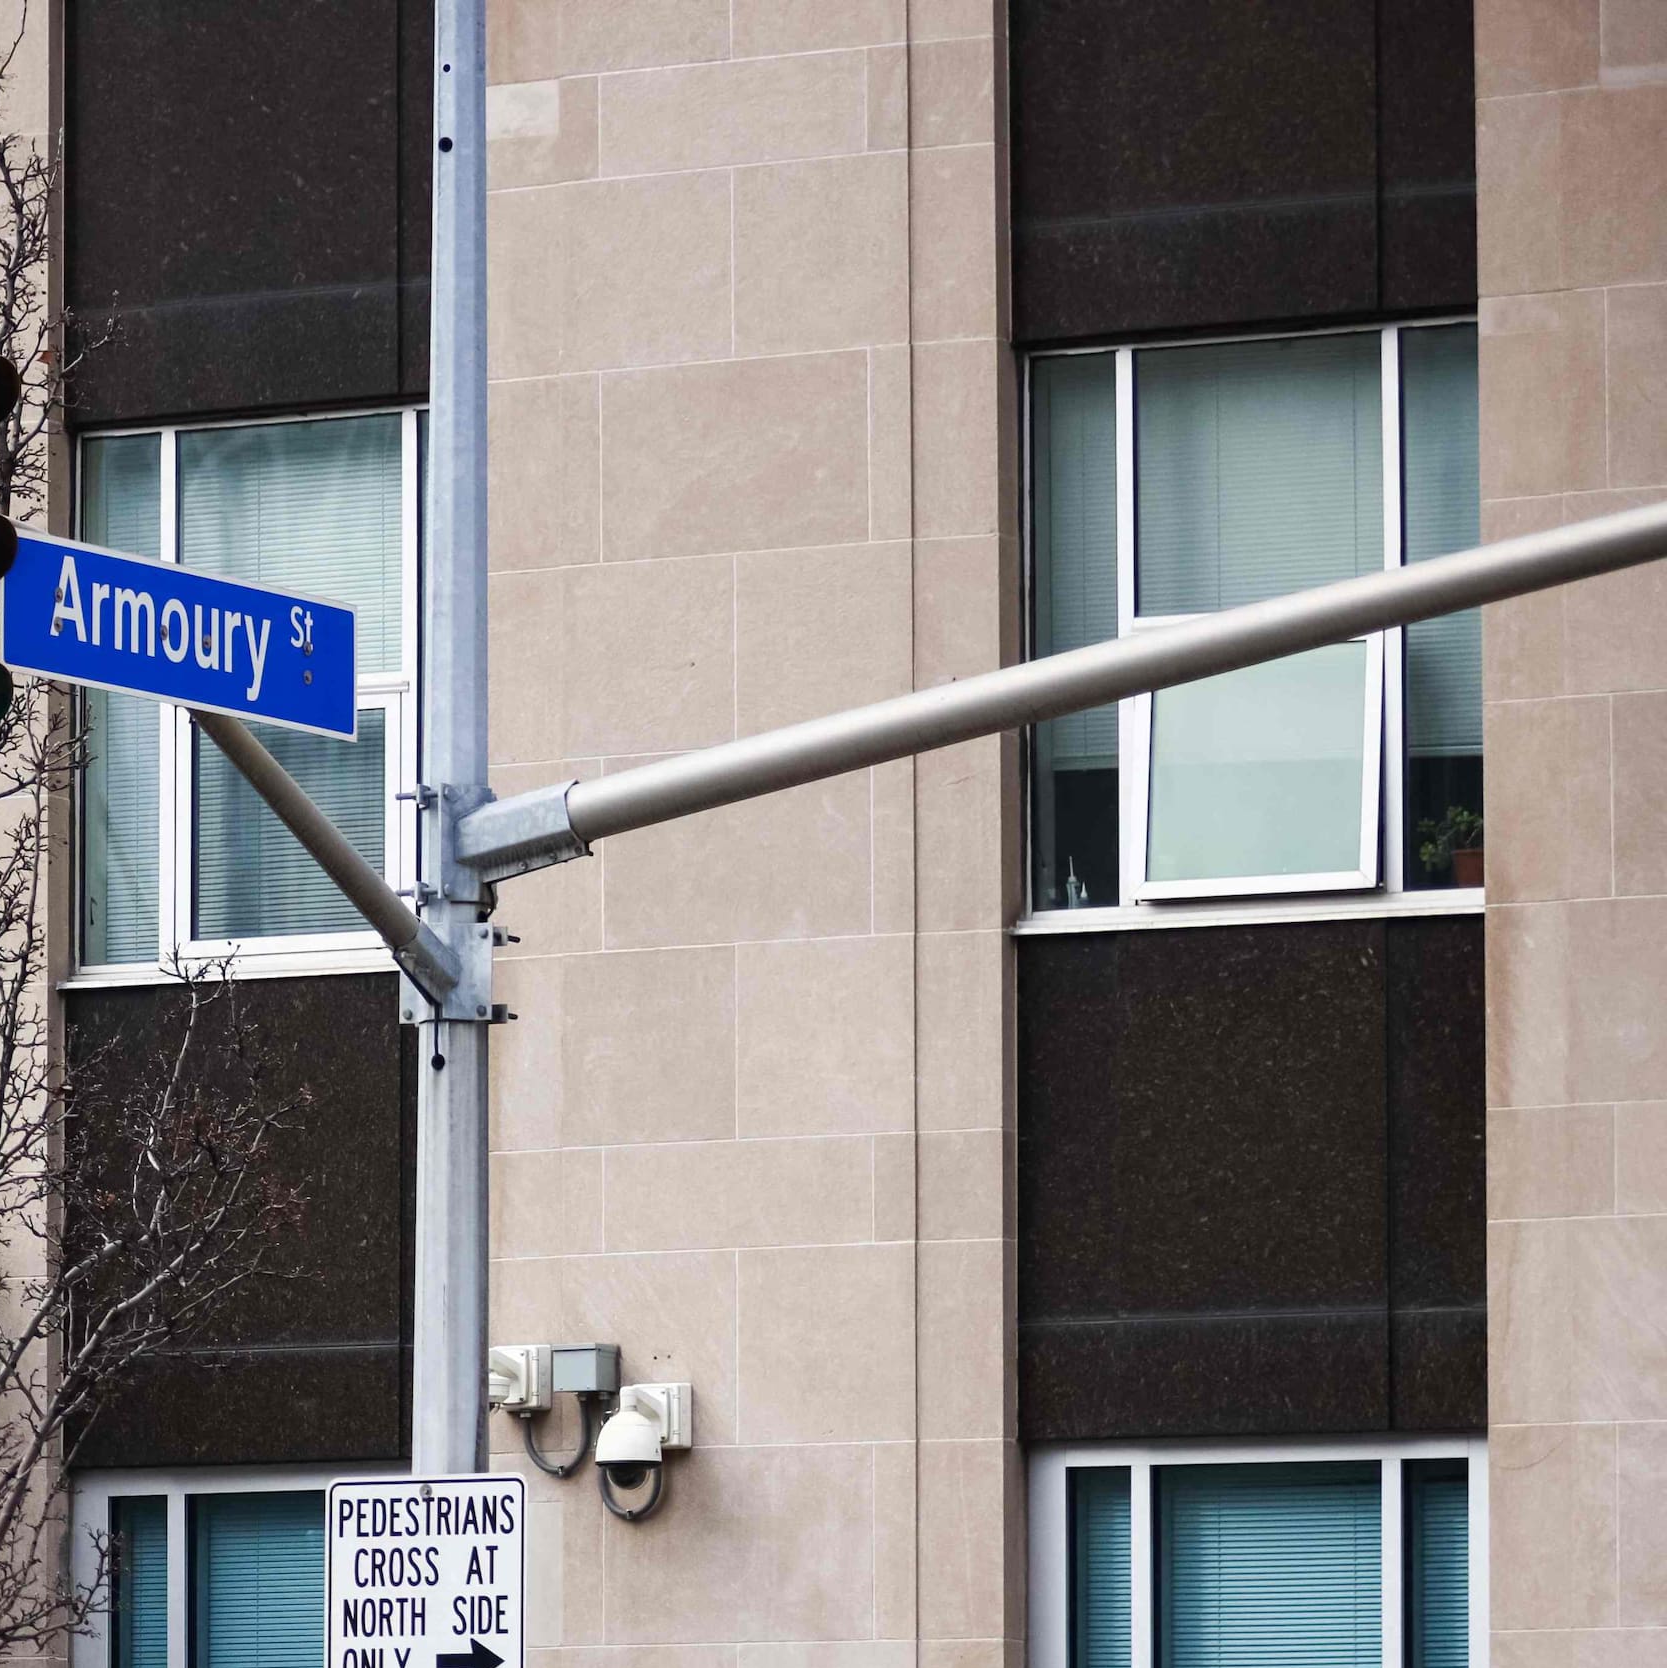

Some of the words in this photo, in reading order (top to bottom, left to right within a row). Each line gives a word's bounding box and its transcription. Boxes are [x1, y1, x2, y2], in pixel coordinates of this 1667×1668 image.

[49, 555, 271, 702] Armoury
[290, 605, 314, 650] St
[338, 1494, 515, 1538] PEDESTRIANS
[354, 1546, 439, 1588] CROSS
[466, 1545, 499, 1585] AT
[343, 1597, 426, 1637] NORTH
[452, 1595, 509, 1635] SIDE
